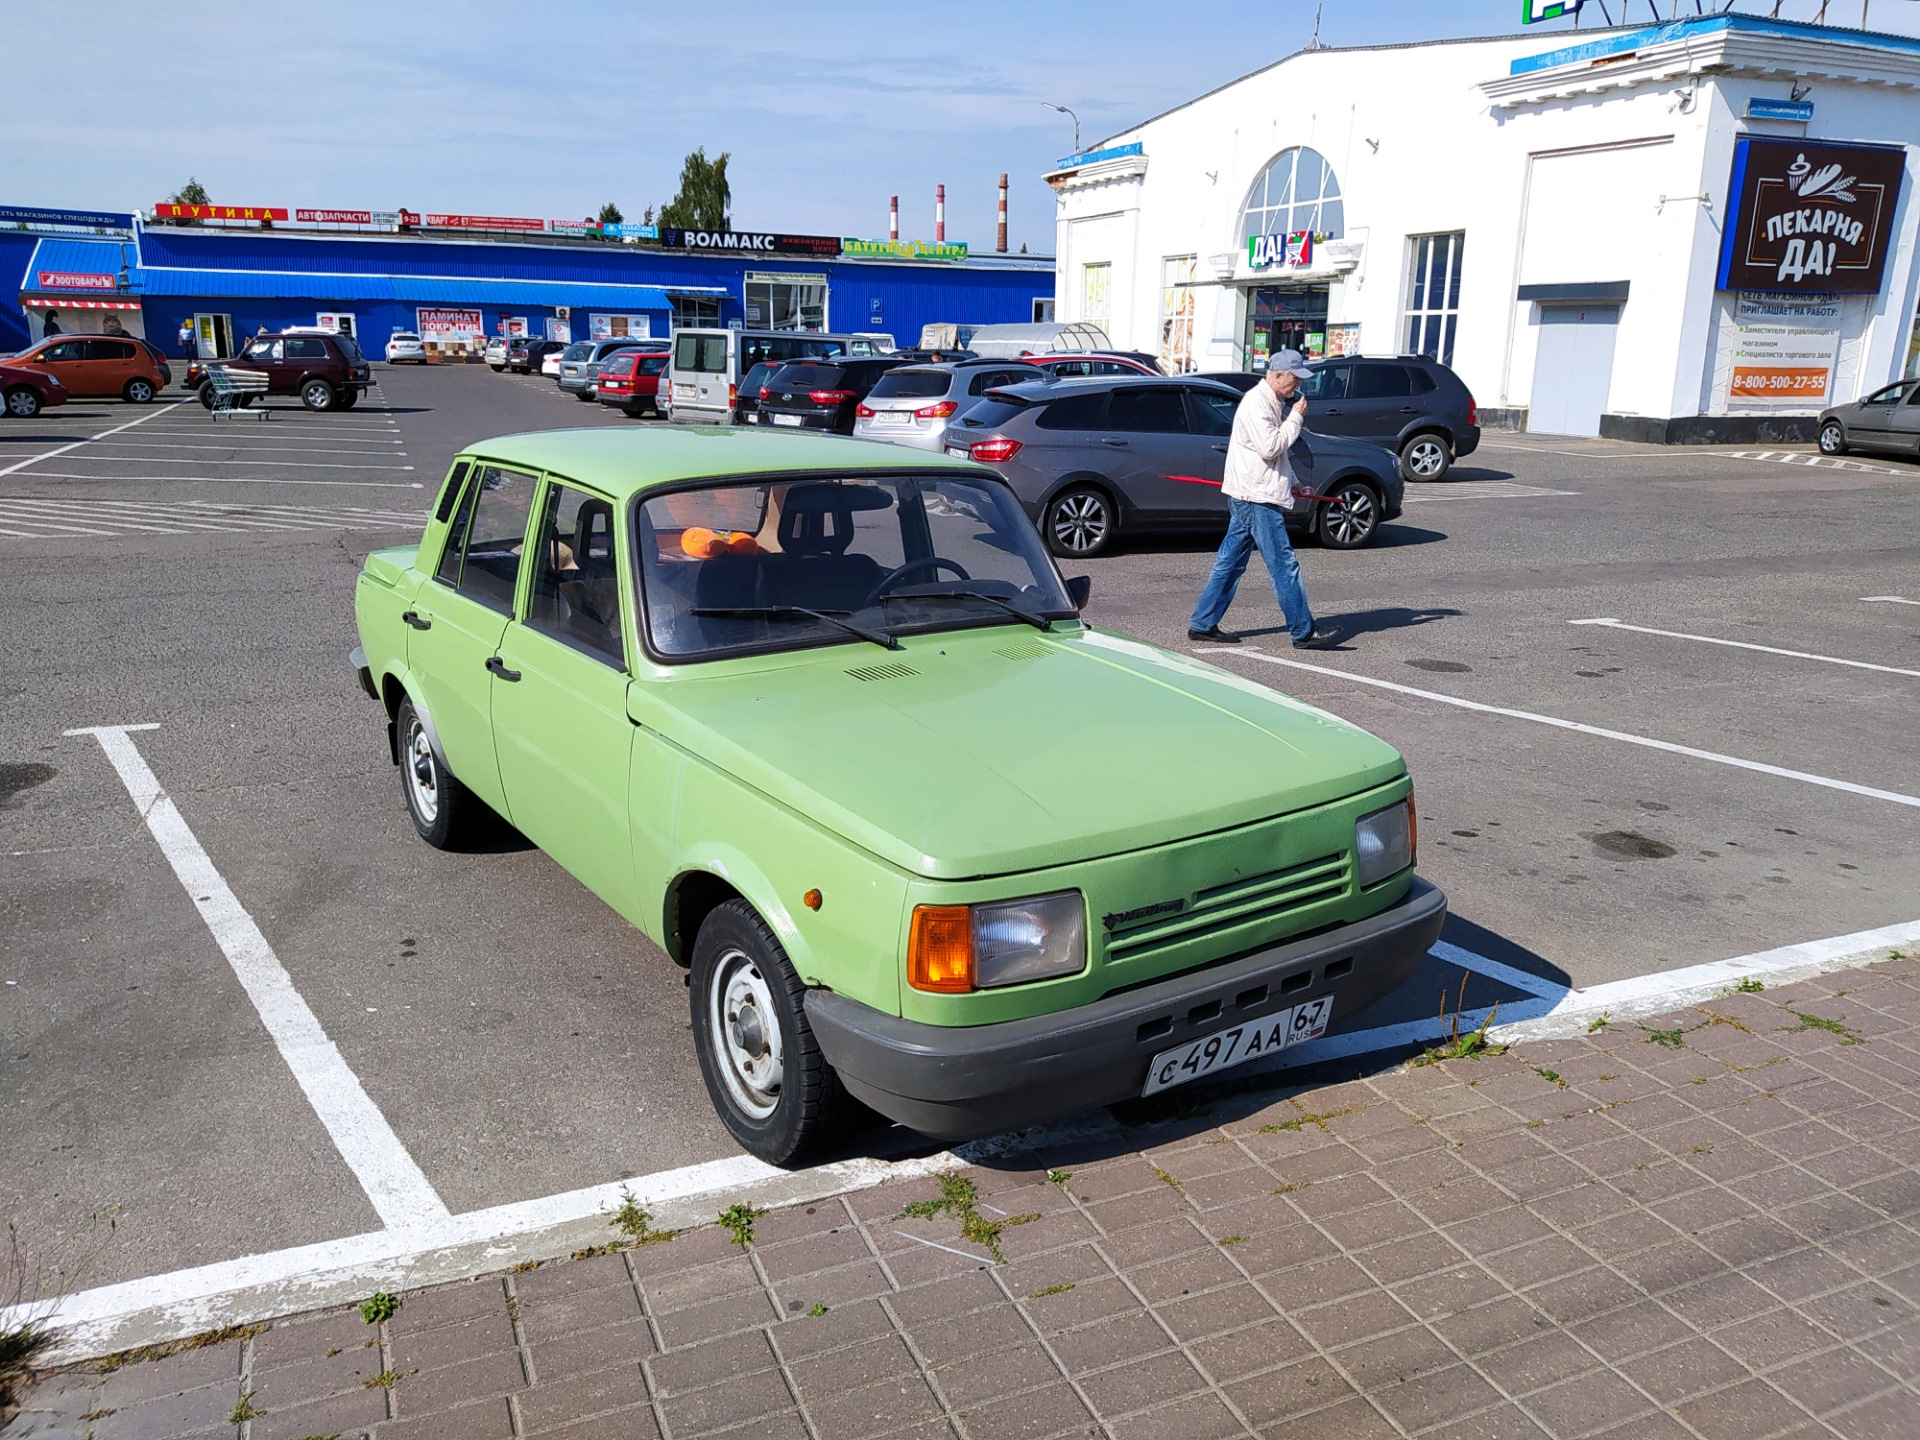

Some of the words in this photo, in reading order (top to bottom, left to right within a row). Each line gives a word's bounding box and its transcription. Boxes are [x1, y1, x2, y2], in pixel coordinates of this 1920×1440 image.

[16, 211, 62, 220] МАГАЗИНОВ
[64, 214, 115, 223] СПЕЦОДЕЖДЫ
[172, 206, 272, 219] ПУТИНА
[298, 211, 369, 222] АВТОЗАПЧАСТИ
[404, 215, 418, 223] 9-22
[553, 221, 597, 229] БЕЛОРУССКИЕ
[1766, 208, 1864, 246] ПЕКАРНЯ
[684, 231, 775, 250] ВОЛМАКС
[782, 237, 837, 246] инженерный
[812, 245, 837, 253] центр
[844, 241, 915, 254] БАТУТНЫЙ
[920, 245, 959, 256] ЦЕНТР
[1251, 234, 1283, 267] ДА!
[1777, 239, 1837, 282] ДА!
[55, 276, 102, 286] ЗООТОВАРЫ
[1742, 291, 1762, 300] СЕТЬ
[1764, 292, 1814, 301] МАГАЗИНОВ
[421, 311, 478, 322] ЛАМИНАТ
[1740, 304, 1792, 316] ПРИГЛАШАЕТ
[1794, 307, 1805, 316] НА
[1807, 307, 1838, 317] РАБОТУ:
[421, 322, 481, 332] ПОКРЫТИЕ
[1743, 326, 1786, 335] Заместителя
[1787, 328, 1835, 337] управляющего
[1742, 340, 1779, 348] магазином
[1741, 350, 1784, 359] Специалиста
[1785, 352, 1816, 360] торгового
[1733, 374, 1826, 389] 8-800-500-27-55
[1288, 1029, 1311, 1043] RUS
[1158, 1023, 1281, 1085] С497АА
[1294, 1001, 1325, 1032] 67
